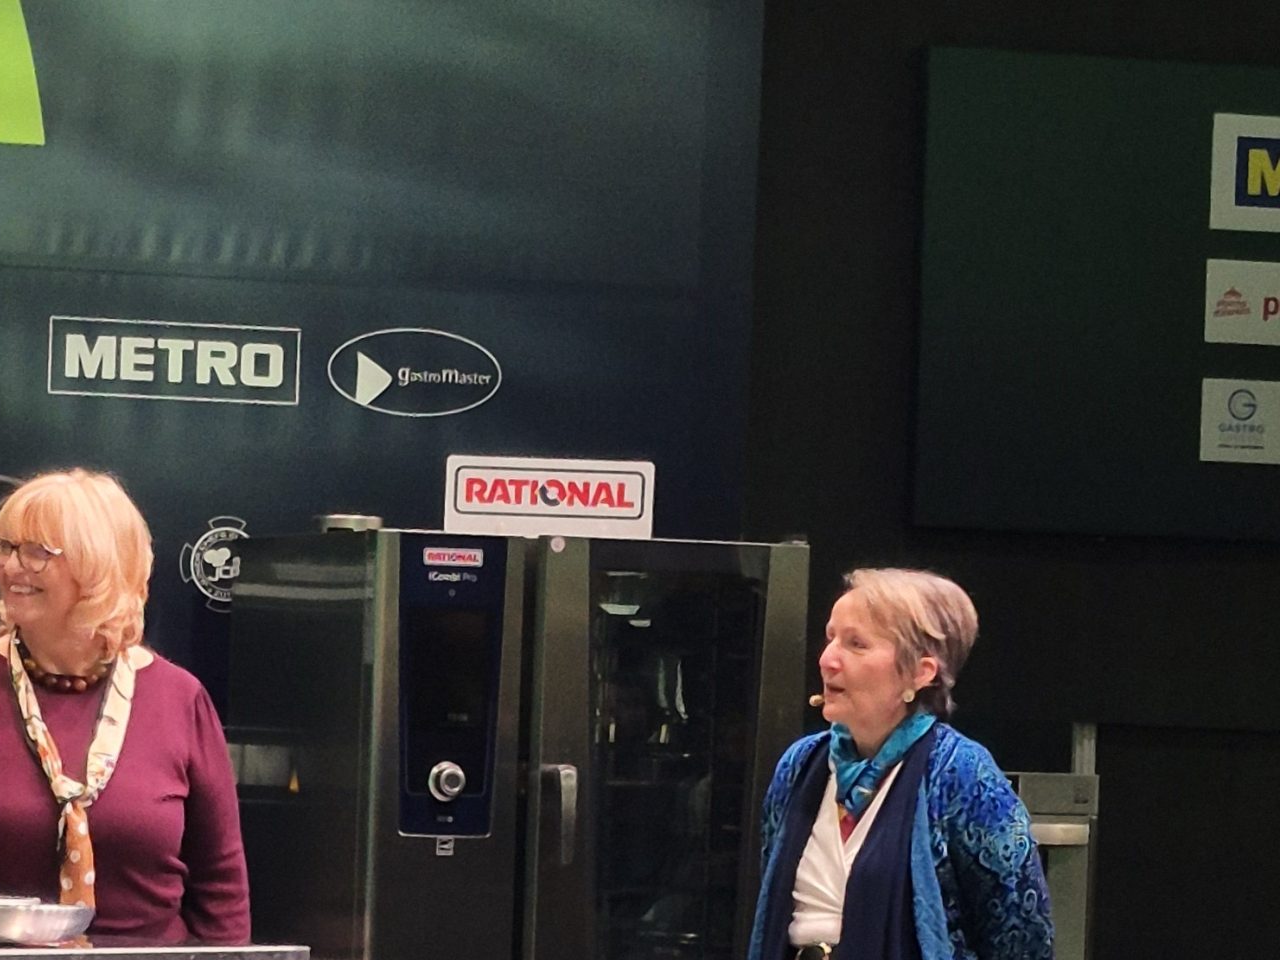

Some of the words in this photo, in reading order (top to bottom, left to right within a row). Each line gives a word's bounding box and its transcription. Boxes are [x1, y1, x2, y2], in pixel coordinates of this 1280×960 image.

[65, 334, 284, 387] METRO
[398, 366, 491, 387] gastroMaster
[465, 478, 635, 508] RATIONAL
[427, 551, 480, 563] RATIONAL
